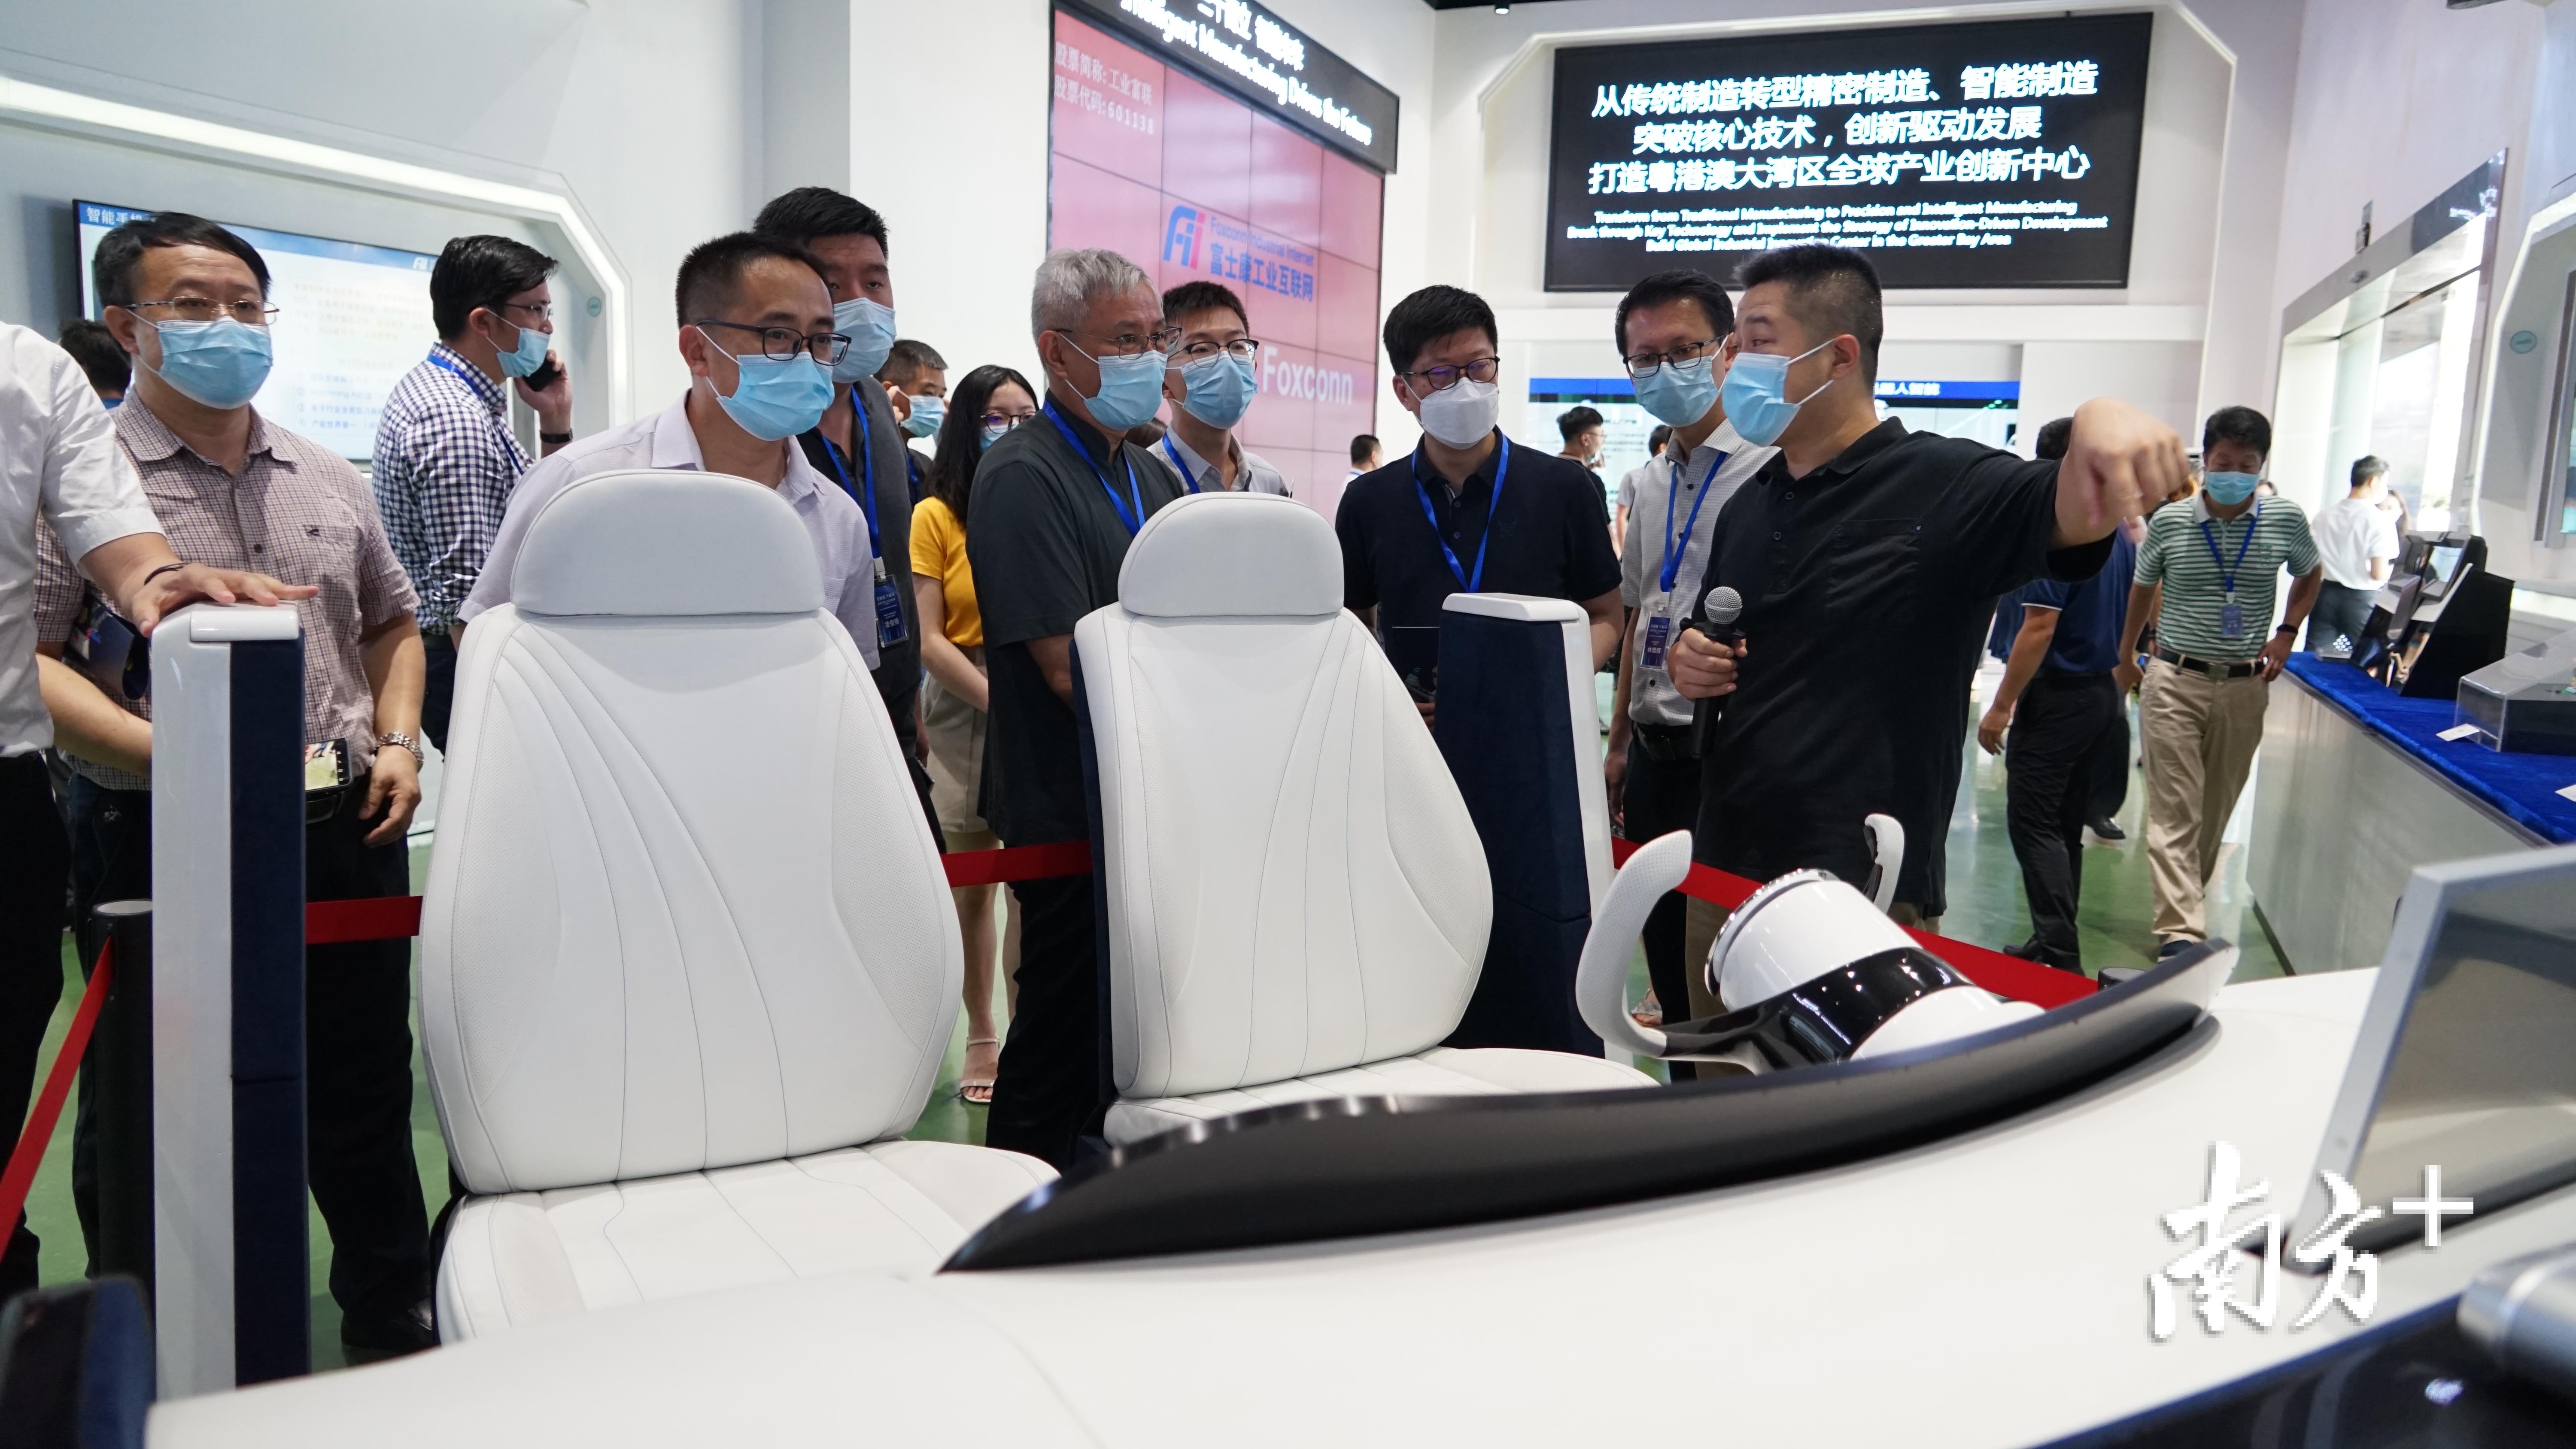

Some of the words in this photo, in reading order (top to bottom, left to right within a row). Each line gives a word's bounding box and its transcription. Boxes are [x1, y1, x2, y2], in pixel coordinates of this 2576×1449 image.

[1199, 24, 1288, 105] Manufacturing
[1288, 77, 1323, 118] Drives
[1323, 98, 1340, 128] the
[1340, 108, 1372, 146] Future
[1589, 146, 2090, 194] 打造粤港澳大湾区全球产业创新中心
[1567, 226, 1598, 238] Break
[1599, 225, 1643, 240] through
[1645, 225, 1666, 239] Key
[1667, 224, 1732, 238] Technology
[1733, 222, 1756, 235] and
[1757, 222, 1819, 236] Implement
[1820, 221, 1841, 233] the
[1843, 220, 1893, 234] Strategy
[1894, 218, 1909, 230] of
[2022, 216, 2108, 231] Development
[1595, 211, 1650, 223] Transform
[1651, 210, 1679, 222] from
[1680, 208, 1740, 221] Traditional
[1741, 206, 1824, 221] Manufacturing
[1826, 207, 1840, 217] to
[1841, 204, 1895, 217] Precision
[1896, 203, 1921, 216] and
[1922, 202, 1984, 217] Intelligent
[1986, 200, 2077, 215] Manufacturing
[1210, 217, 1247, 243] Foxconn
[1248, 232, 1286, 257] Industrial
[1287, 246, 1314, 267] Internet
[1646, 239, 1674, 251] Build
[1675, 238, 1712, 251] Global
[1713, 237, 1766, 250] Industrial
[1830, 236, 1871, 247] Center
[1872, 235, 1884, 247] in
[1886, 234, 1907, 246] the
[1908, 234, 1955, 246] Greater
[1956, 233, 1981, 248] Bay
[1981, 233, 2011, 245] Area
[1210, 243, 1313, 303] 富士康工业互联网
[1263, 345, 1352, 405] Foxconn
